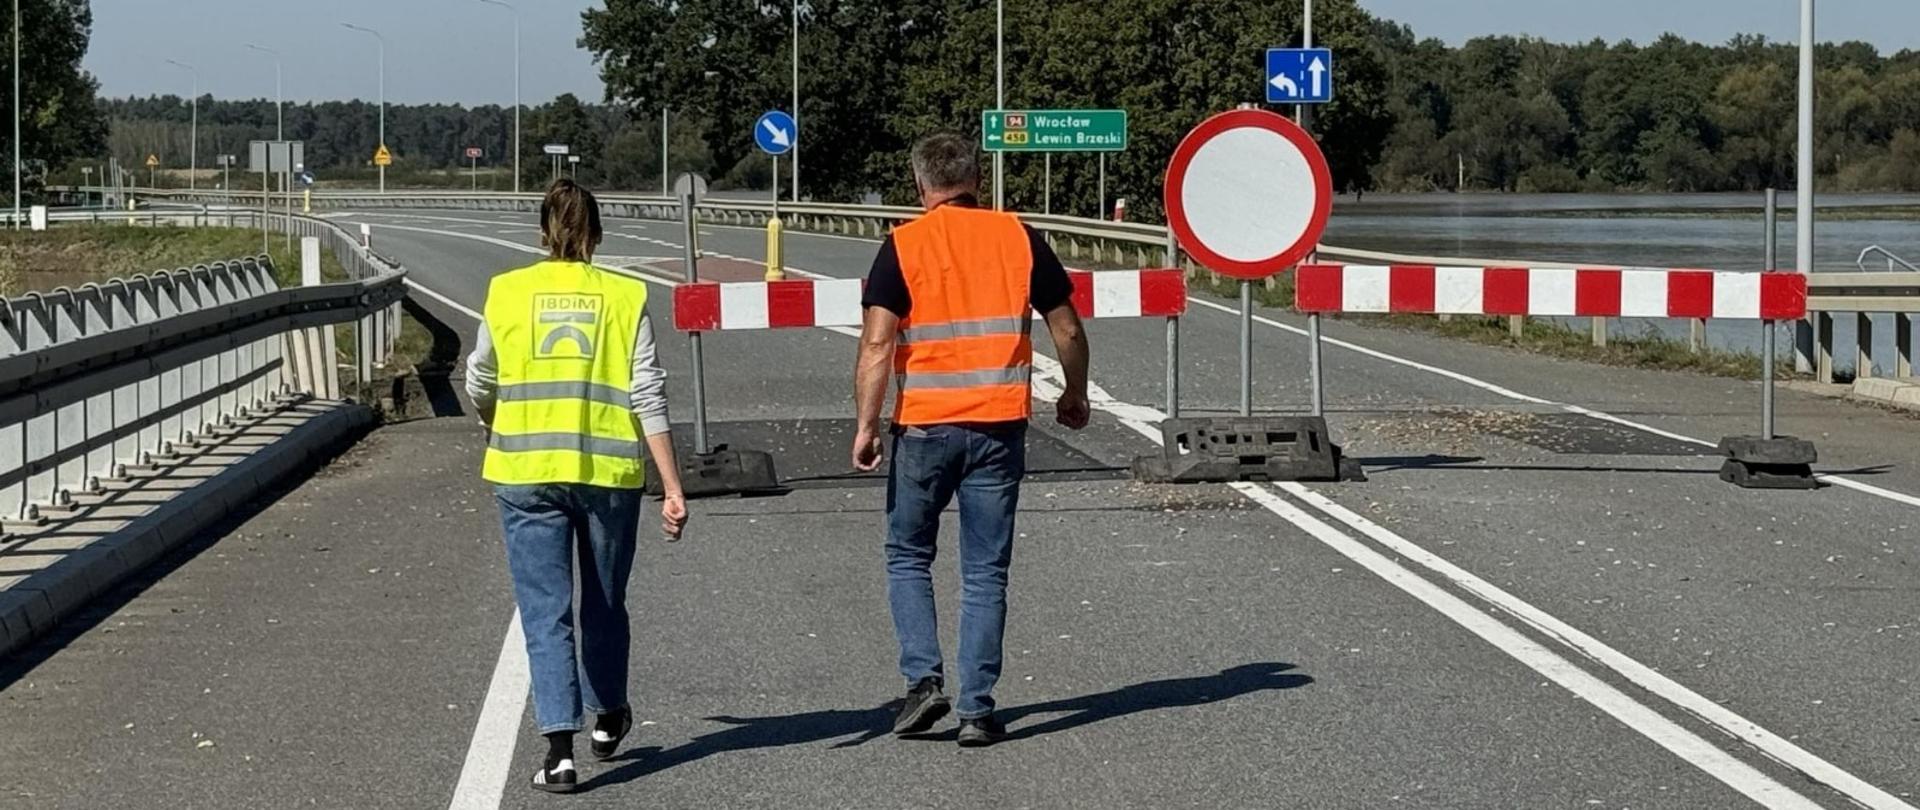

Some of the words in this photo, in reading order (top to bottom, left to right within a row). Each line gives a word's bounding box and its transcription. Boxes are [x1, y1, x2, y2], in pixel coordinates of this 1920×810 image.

[1010, 116, 1022, 126] 94
[1034, 116, 1091, 128] Wrocław
[1034, 132, 1072, 144] Lewin
[1077, 132, 1121, 144] Brzeski
[541, 297, 596, 310] IBDiM
